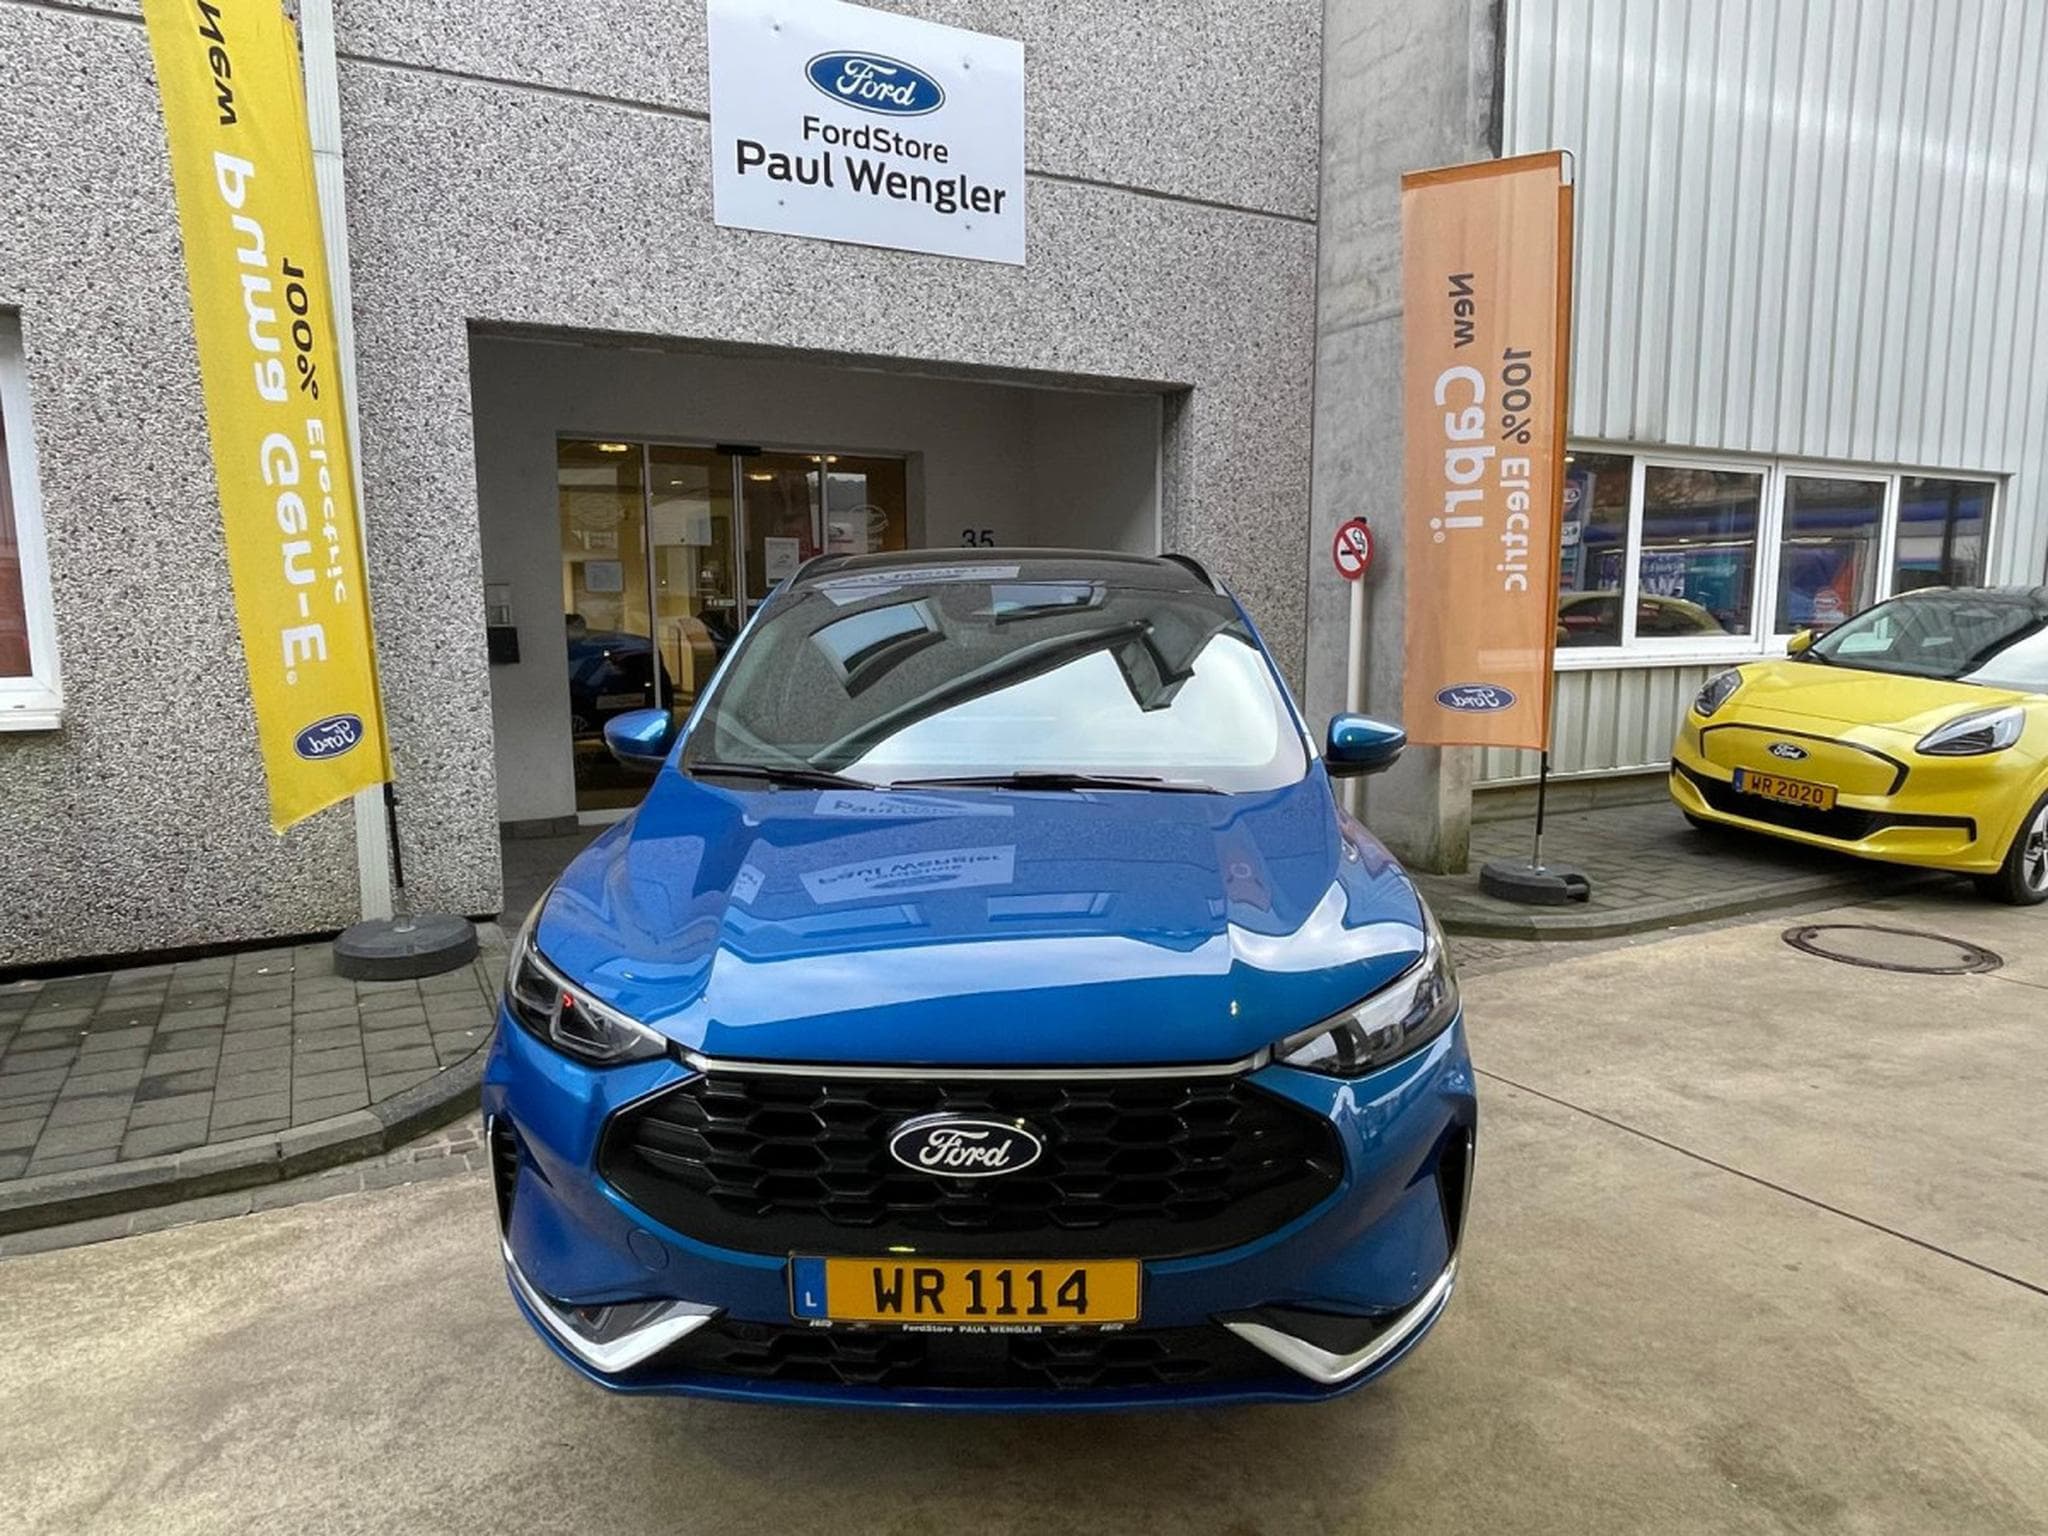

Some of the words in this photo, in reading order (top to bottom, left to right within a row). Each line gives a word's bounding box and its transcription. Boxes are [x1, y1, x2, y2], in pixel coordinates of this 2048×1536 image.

[836, 58, 916, 106] Ford
[802, 115, 949, 164] FordStore
[736, 138, 833, 188] Paul
[846, 156, 1007, 214] Wengler
[961, 529, 995, 548] 35
[1774, 744, 1801, 759] Ford
[1751, 775, 1773, 794] WR
[1776, 781, 1824, 805] 2020
[919, 1128, 1011, 1168] Ford
[805, 1291, 818, 1308] L
[873, 1267, 946, 1315] WR
[964, 1268, 1089, 1316] 1114
[959, 1325, 987, 1334] PAUL
[989, 1325, 1042, 1334] WENGLER
